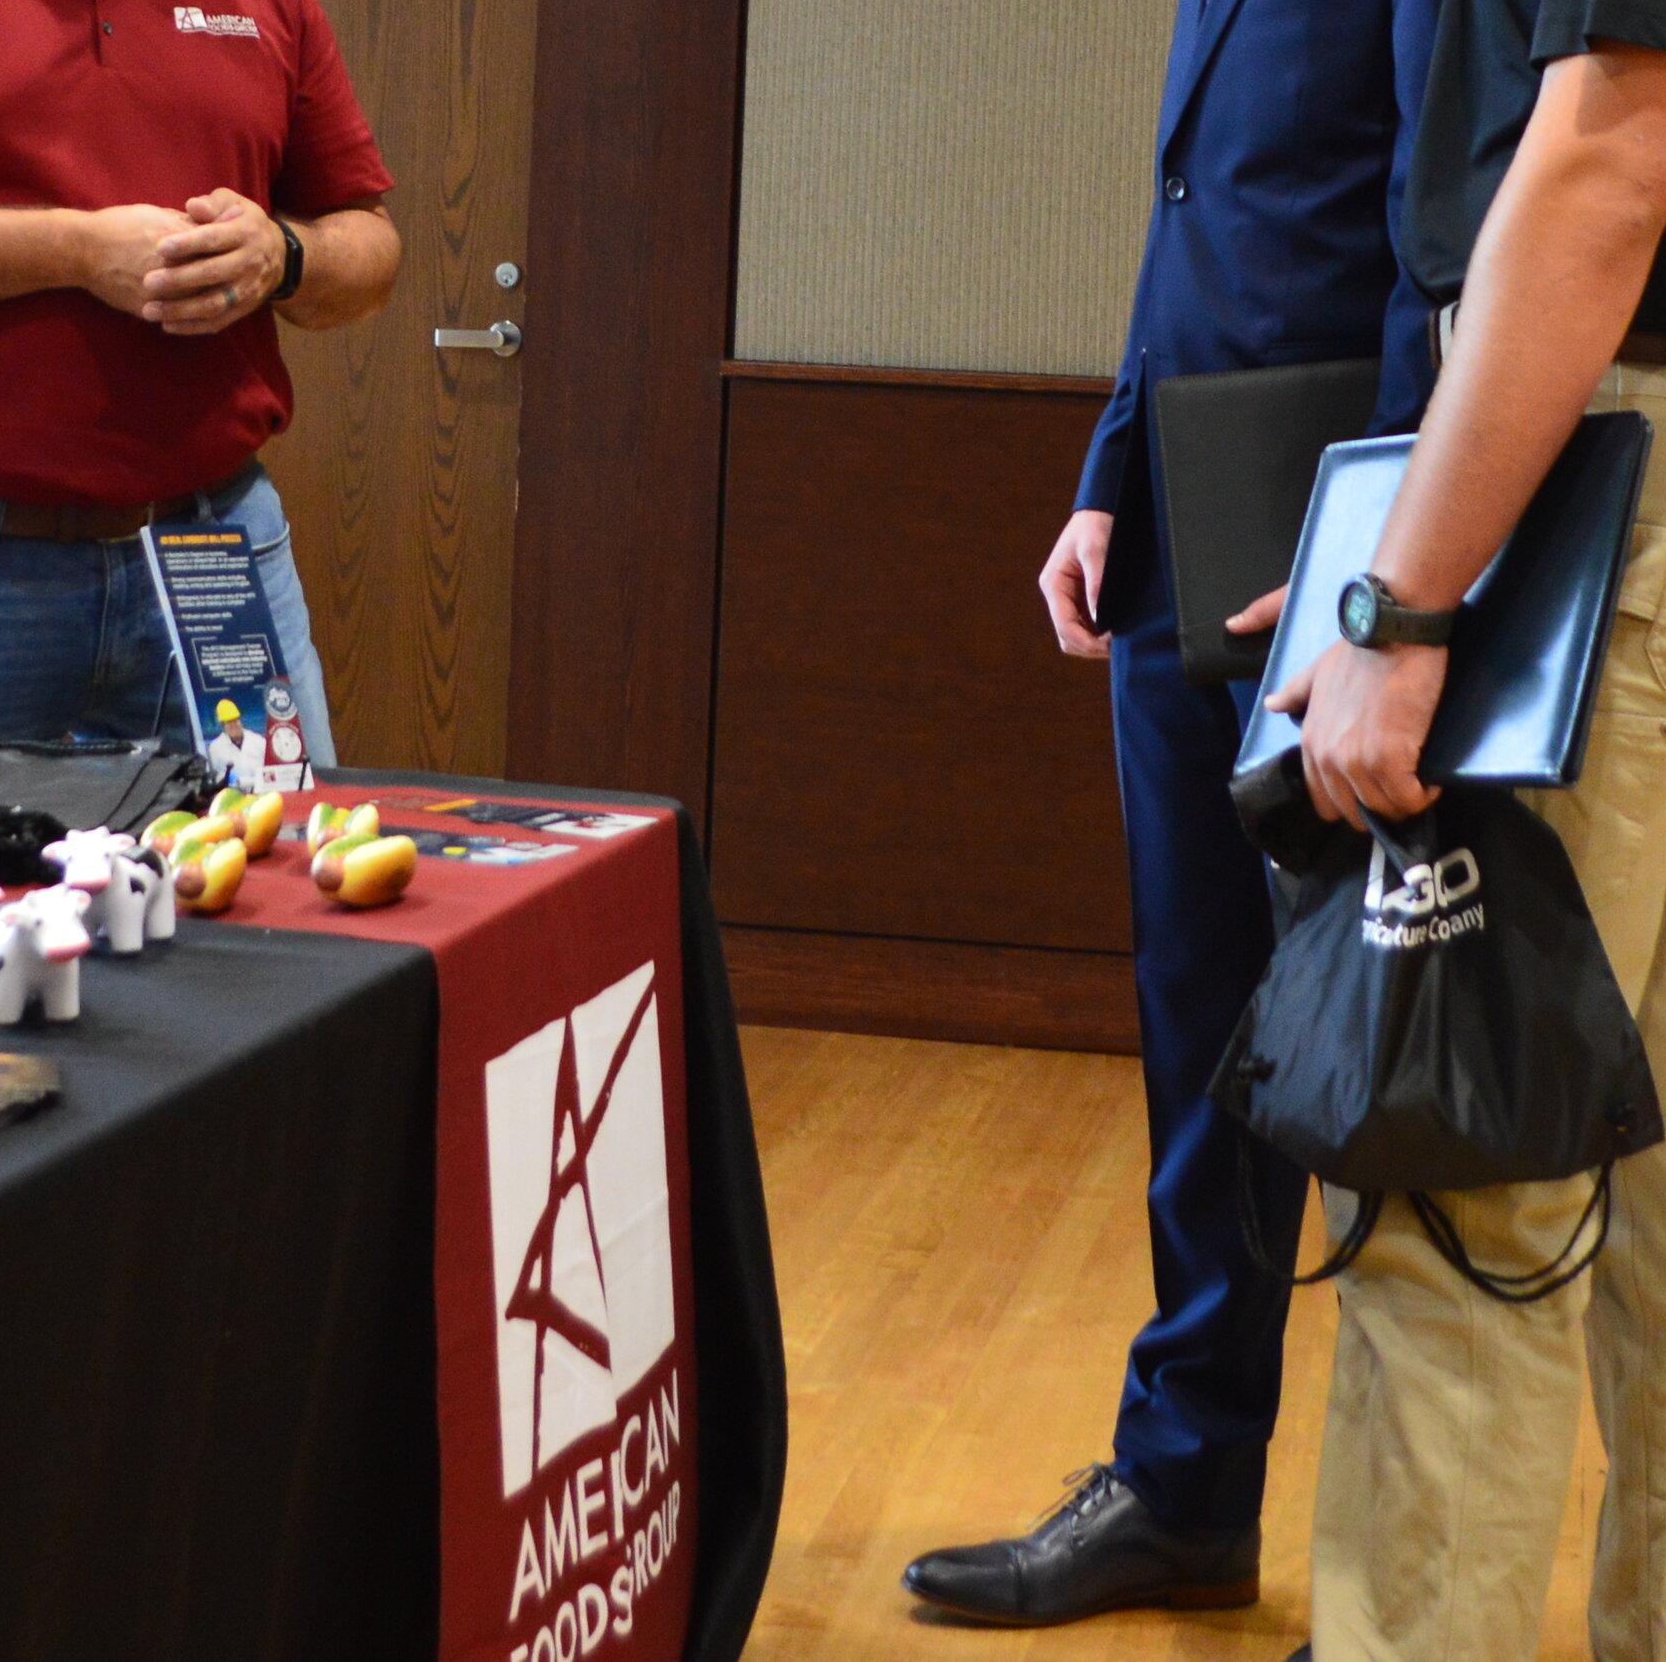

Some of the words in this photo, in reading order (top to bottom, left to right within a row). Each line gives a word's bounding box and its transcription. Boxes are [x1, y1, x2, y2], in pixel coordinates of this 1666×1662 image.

[509, 1367, 680, 1622] AMEICAN
[510, 1563, 634, 1662] OODS
[626, 1480, 681, 1598] ROUP
